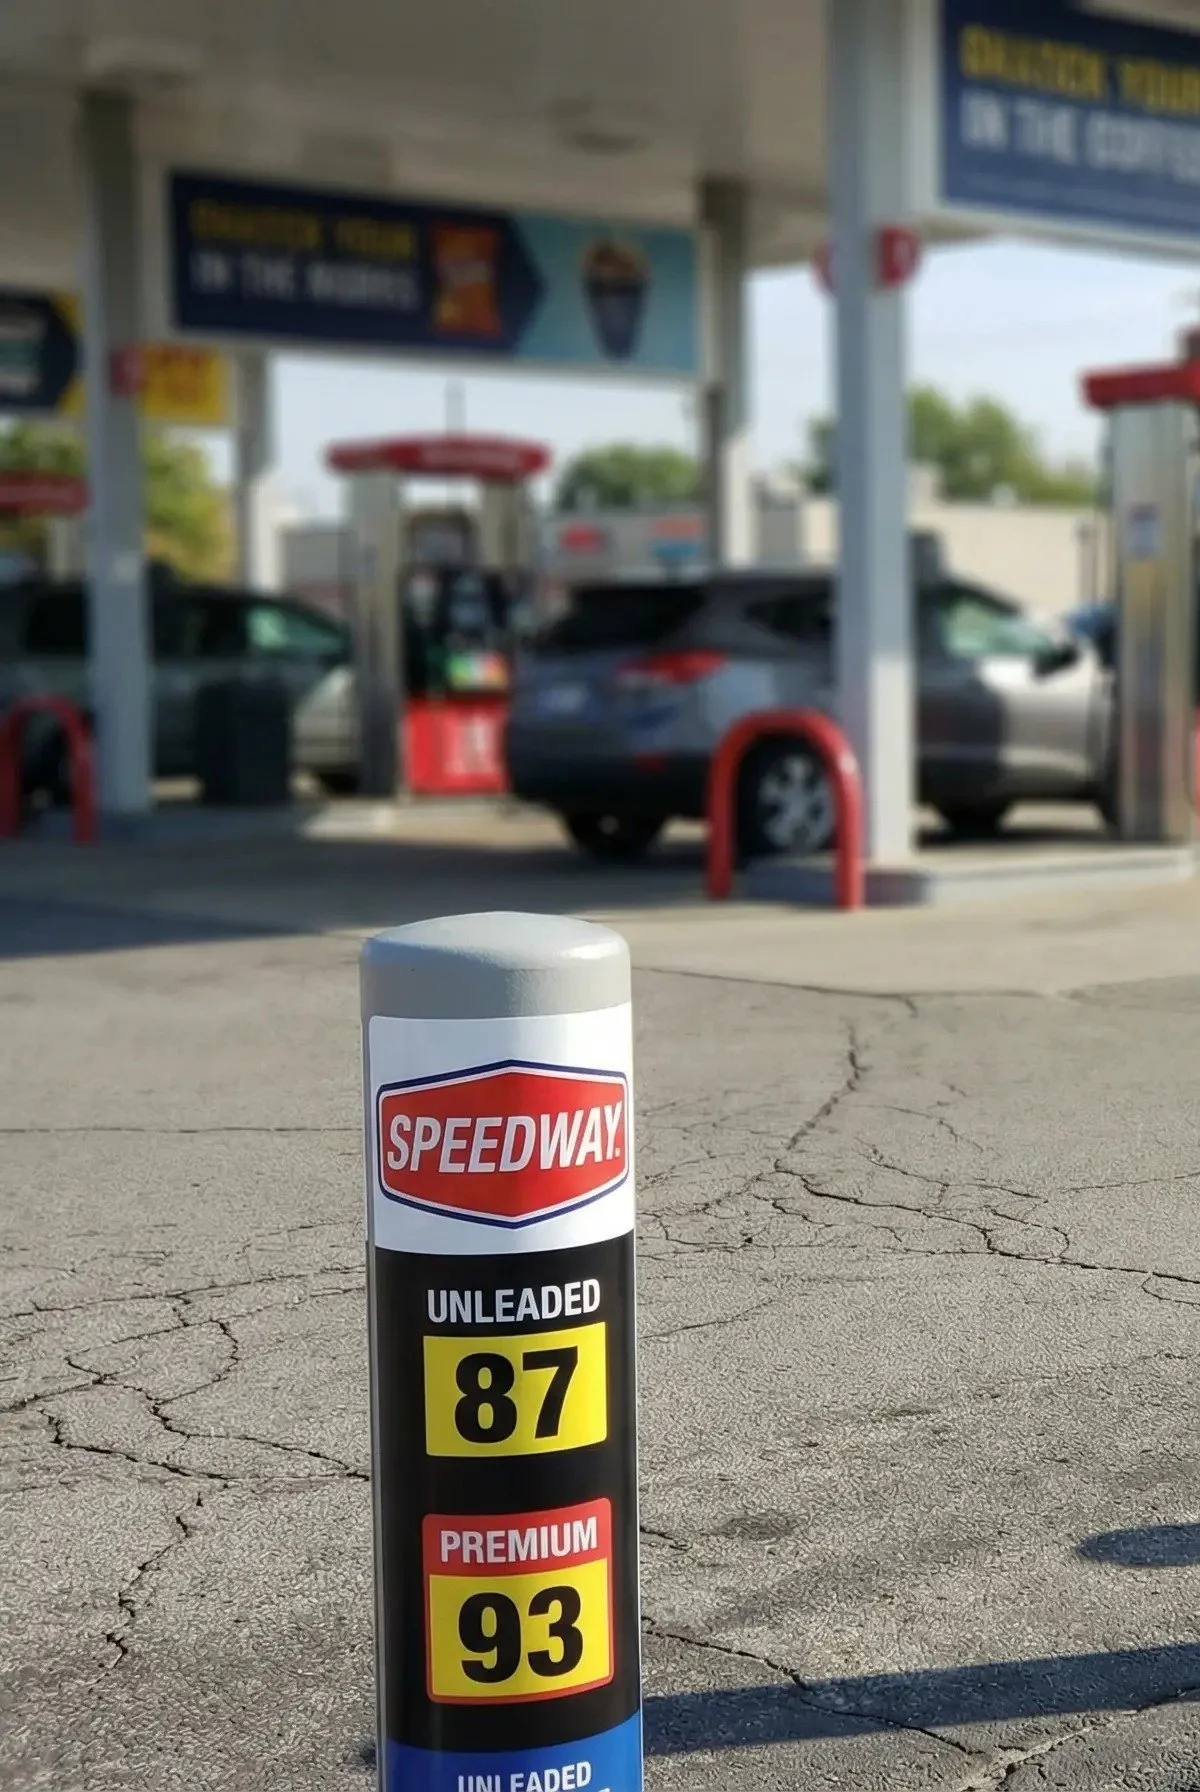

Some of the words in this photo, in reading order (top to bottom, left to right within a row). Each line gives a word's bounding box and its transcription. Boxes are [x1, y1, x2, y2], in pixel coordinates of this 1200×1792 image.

[427, 1279, 601, 1323] UNLEADED
[455, 1345, 578, 1444] 87
[440, 1517, 598, 1564] PREMIUM
[458, 1585, 584, 1684] 93
